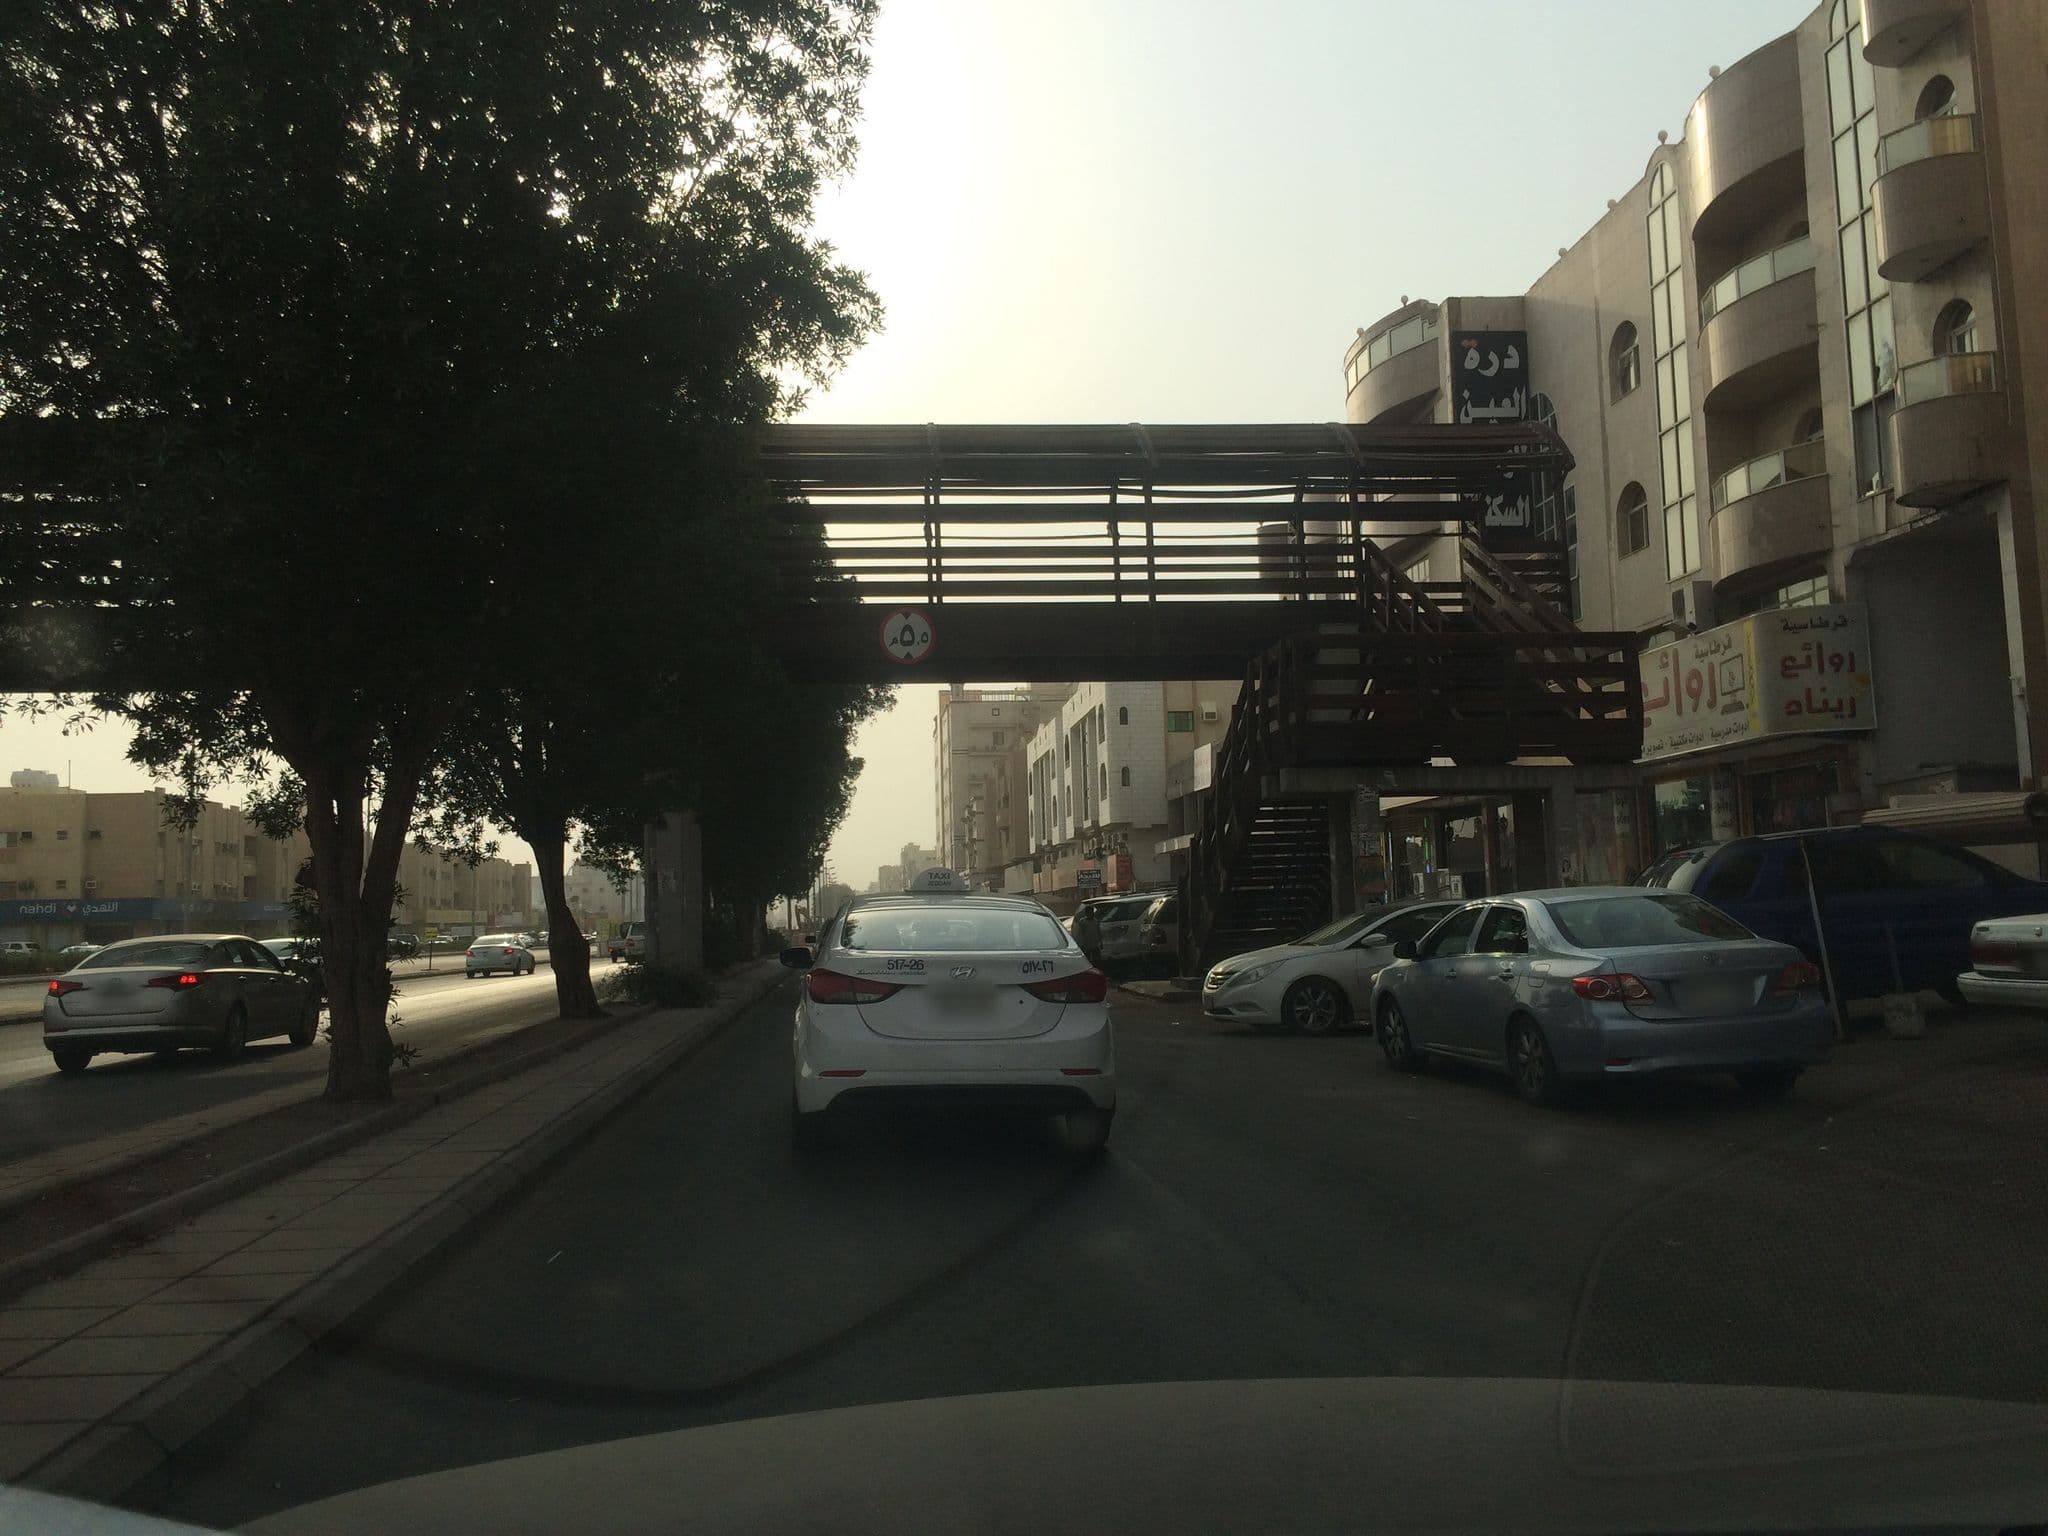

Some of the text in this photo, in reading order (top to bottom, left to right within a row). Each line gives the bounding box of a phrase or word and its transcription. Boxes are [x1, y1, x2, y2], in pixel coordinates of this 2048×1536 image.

[1484, 494, 1531, 528] السكن
[1780, 641, 1856, 679] روائع
[1642, 648, 1718, 727] روائ
[1783, 687, 1857, 718] ريناد
[927, 872, 951, 880] TAXI
[19, 903, 57, 914] nahdi
[82, 902, 118, 917] النهدي
[887, 958, 925, 971] 517-26
